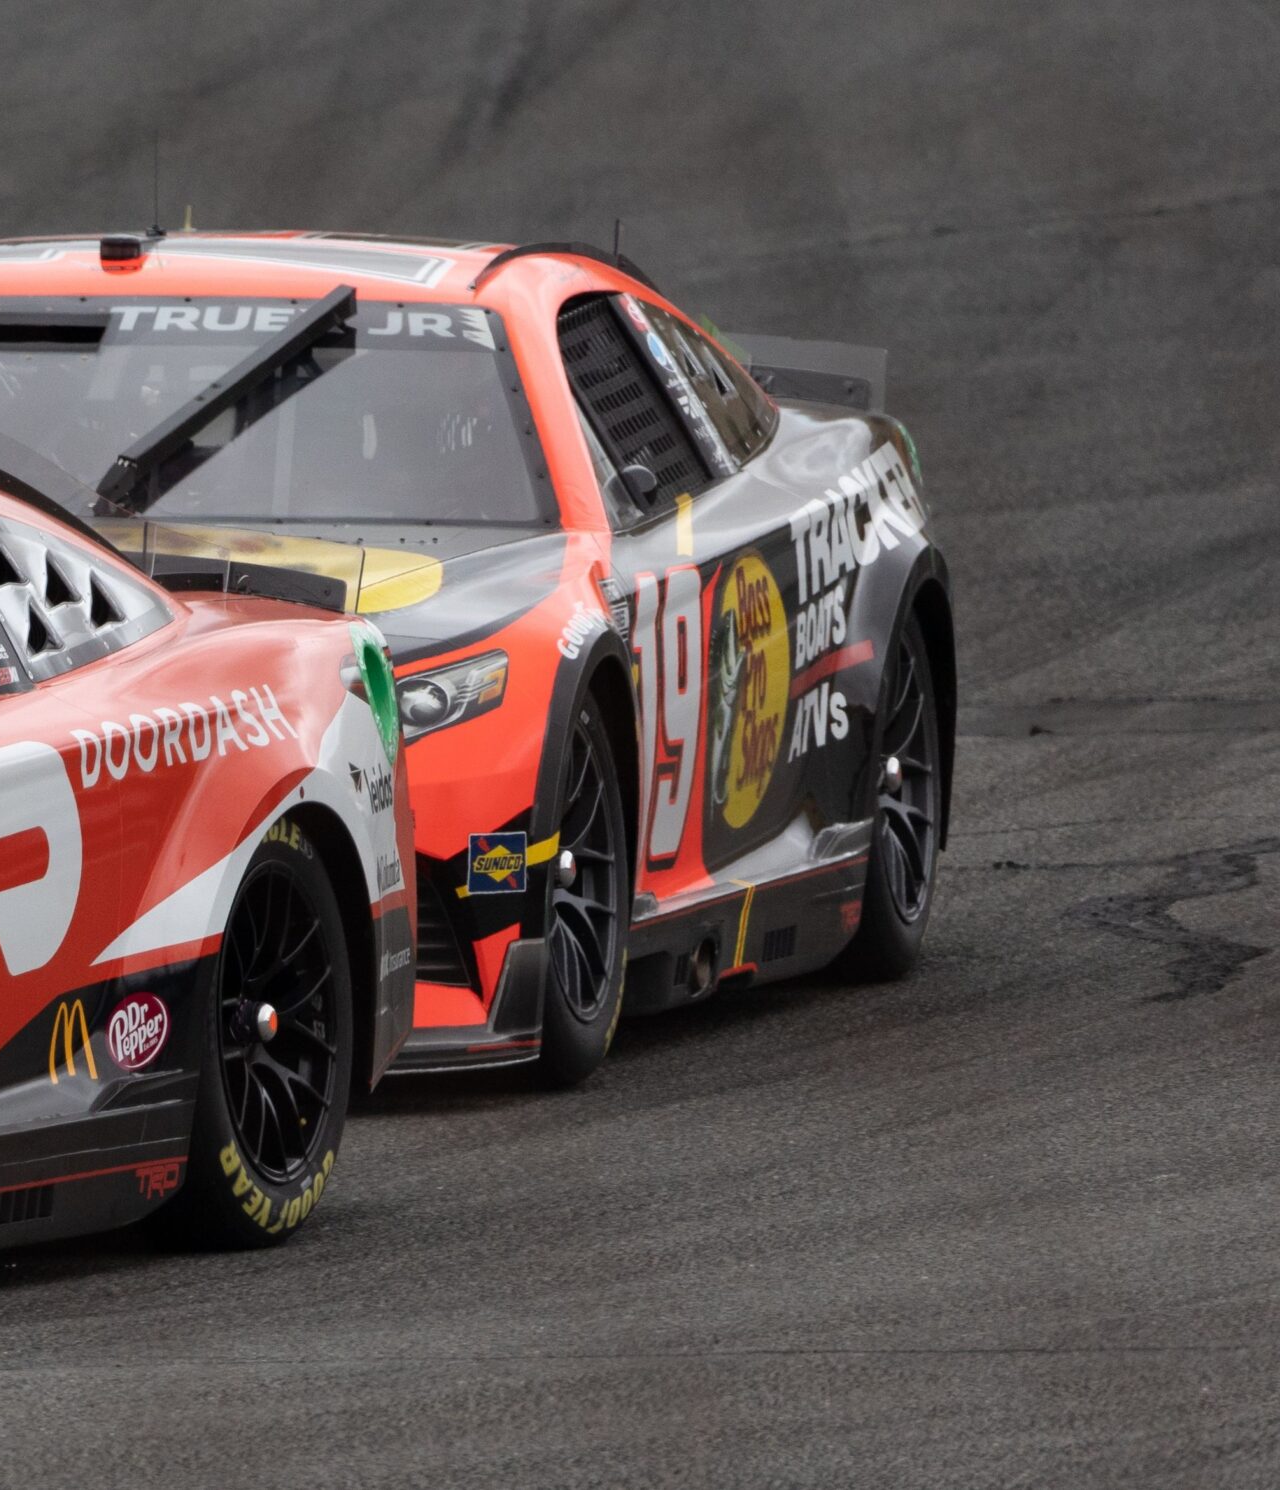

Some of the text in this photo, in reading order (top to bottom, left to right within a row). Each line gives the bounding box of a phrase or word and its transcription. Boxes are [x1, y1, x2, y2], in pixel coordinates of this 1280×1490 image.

[110, 306, 456, 338] TRUE JR
[788, 441, 929, 605] TRACKER
[736, 567, 771, 640] Bass
[795, 584, 847, 670] BOATS
[741, 640, 767, 712] Pro
[70, 684, 299, 789] DOORDASH
[631, 566, 701, 872] 19
[363, 763, 393, 815] leidos
[474, 855, 522, 871] SUNOCO
[109, 1010, 162, 1062] Pepper
[127, 1002, 148, 1031] Dr
[135, 1164, 180, 1200] TRD
